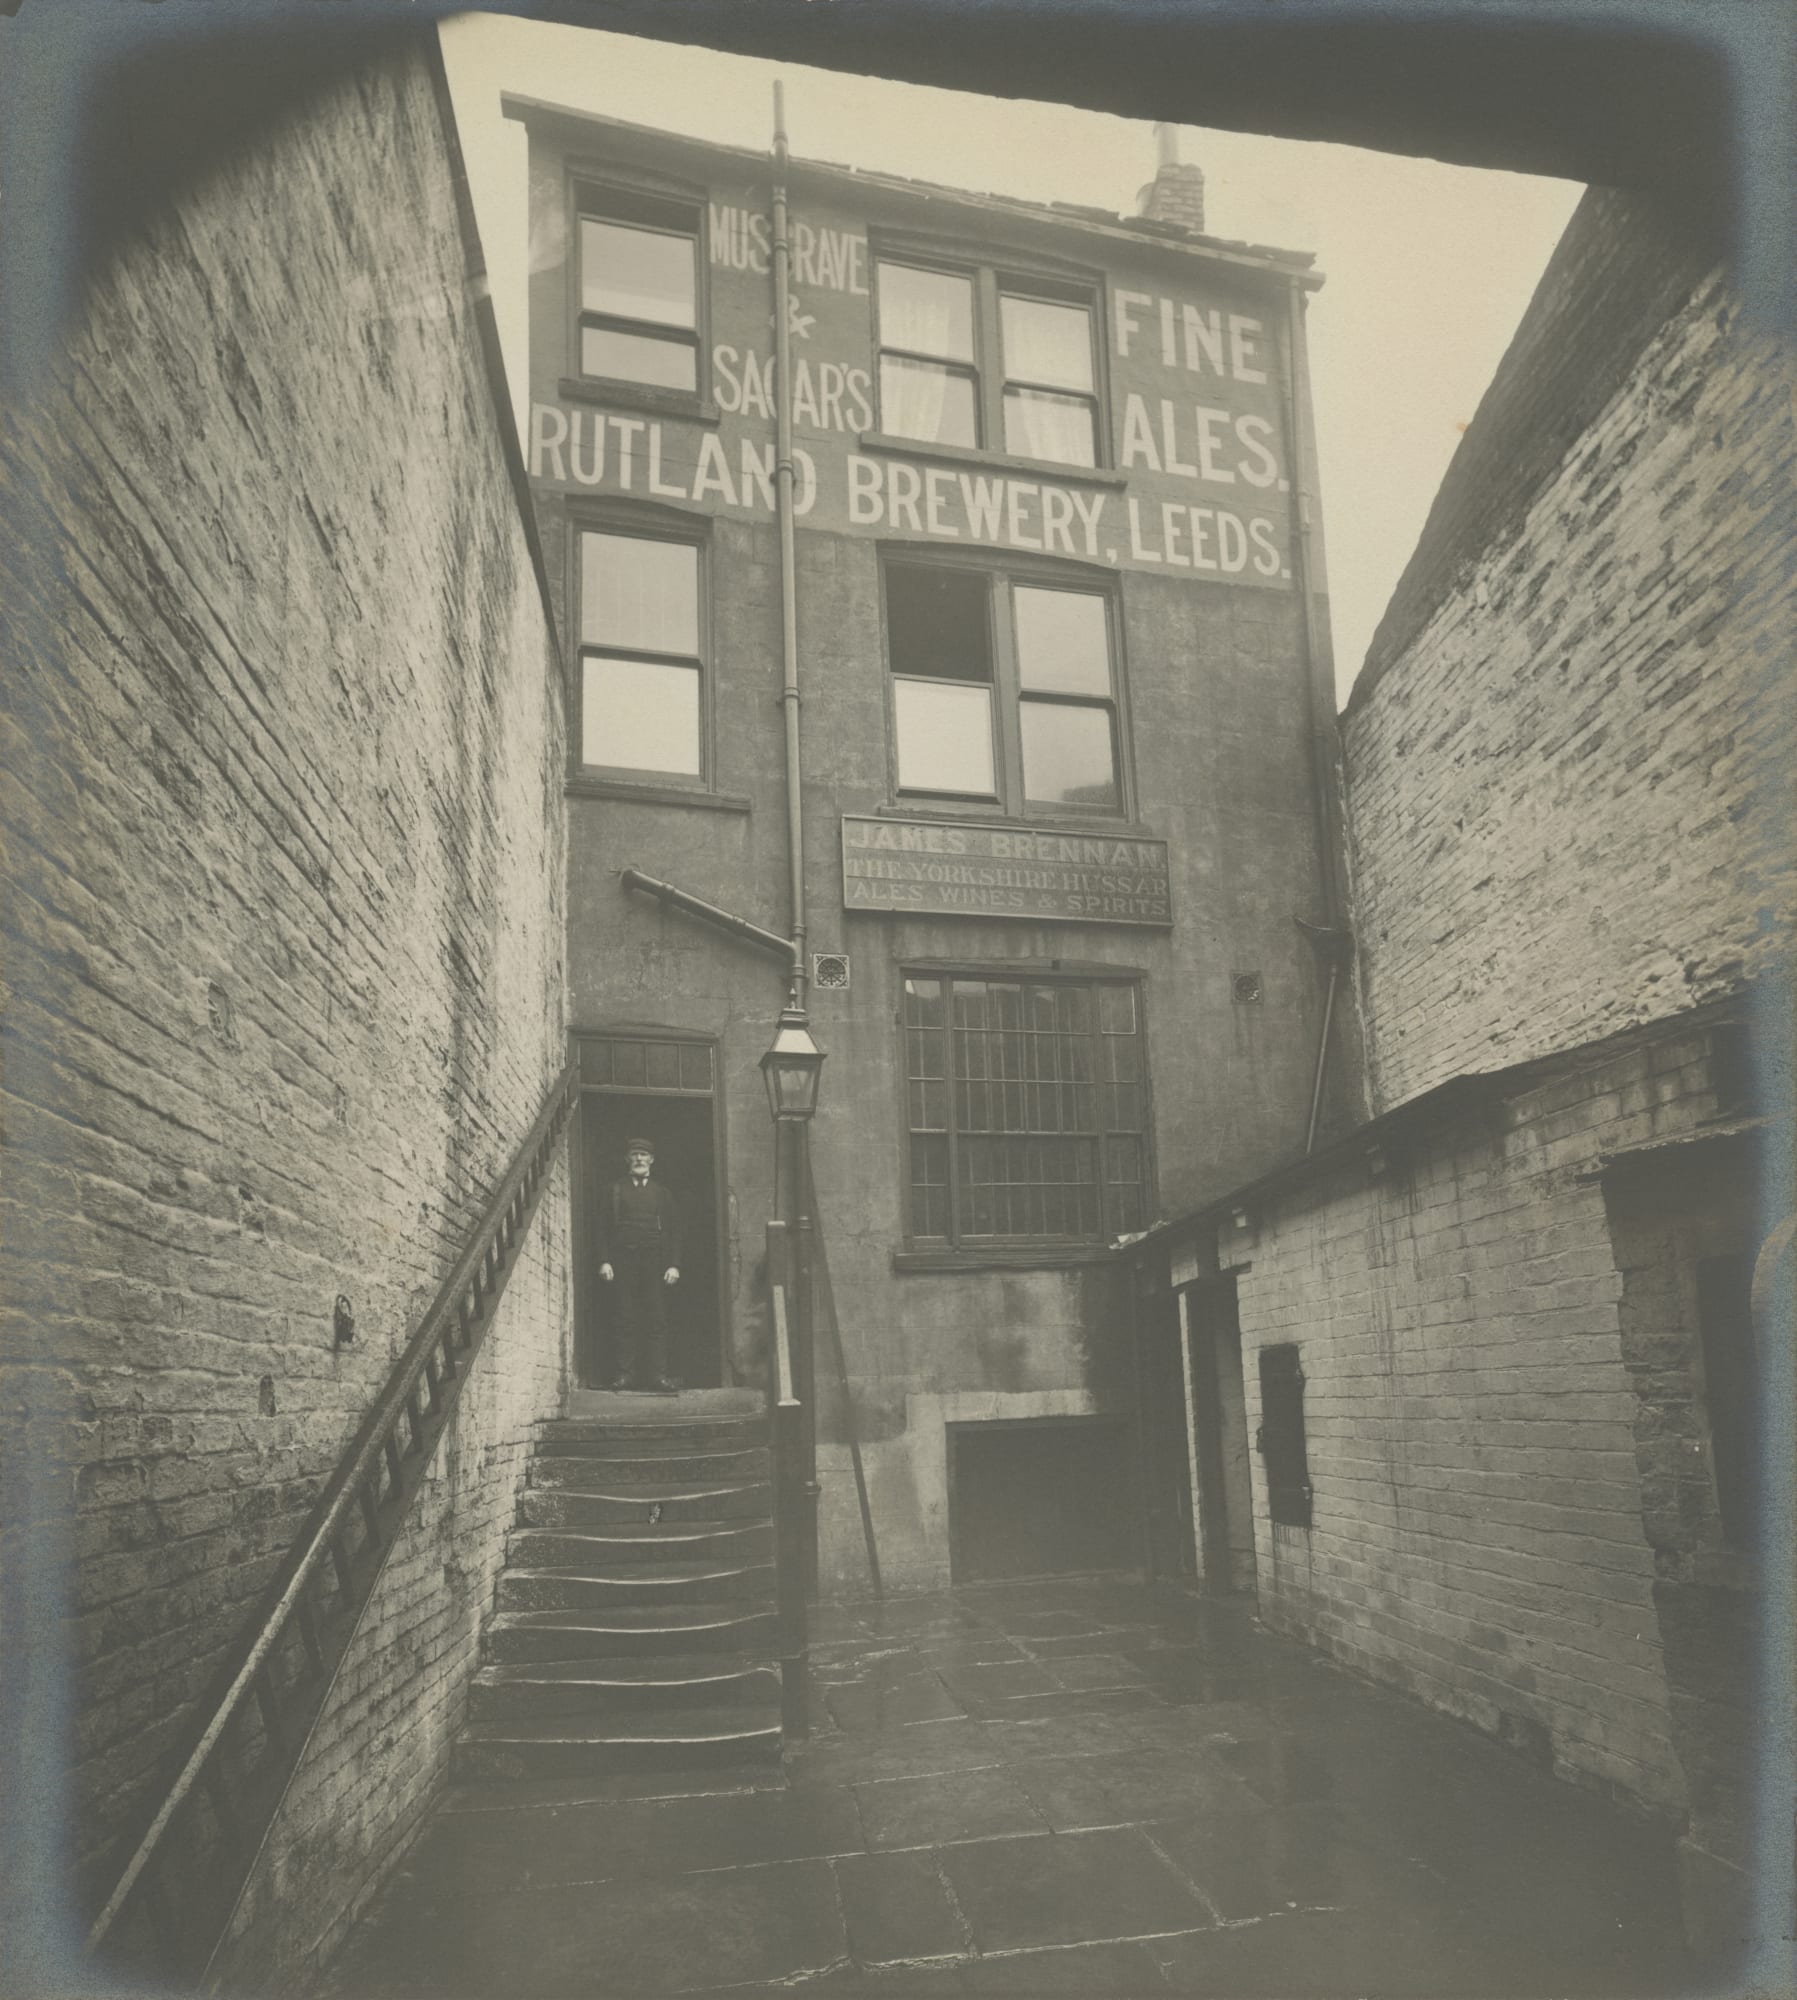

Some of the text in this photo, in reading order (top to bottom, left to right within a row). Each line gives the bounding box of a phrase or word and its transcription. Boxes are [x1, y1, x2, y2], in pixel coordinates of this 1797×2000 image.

[708, 202, 870, 296] MUSRAVE
[768, 293, 816, 339] &
[1114, 289, 1267, 384] FINE
[1121, 393, 1290, 491] ALES.
[529, 402, 1292, 579] RUTLAND BREWERY, LEEDS.
[849, 823, 967, 855] JAMES
[848, 858, 1168, 897] THE YORKSHIRE HUSSAR
[853, 880, 1168, 917] ALES WINES & SPIRITS
